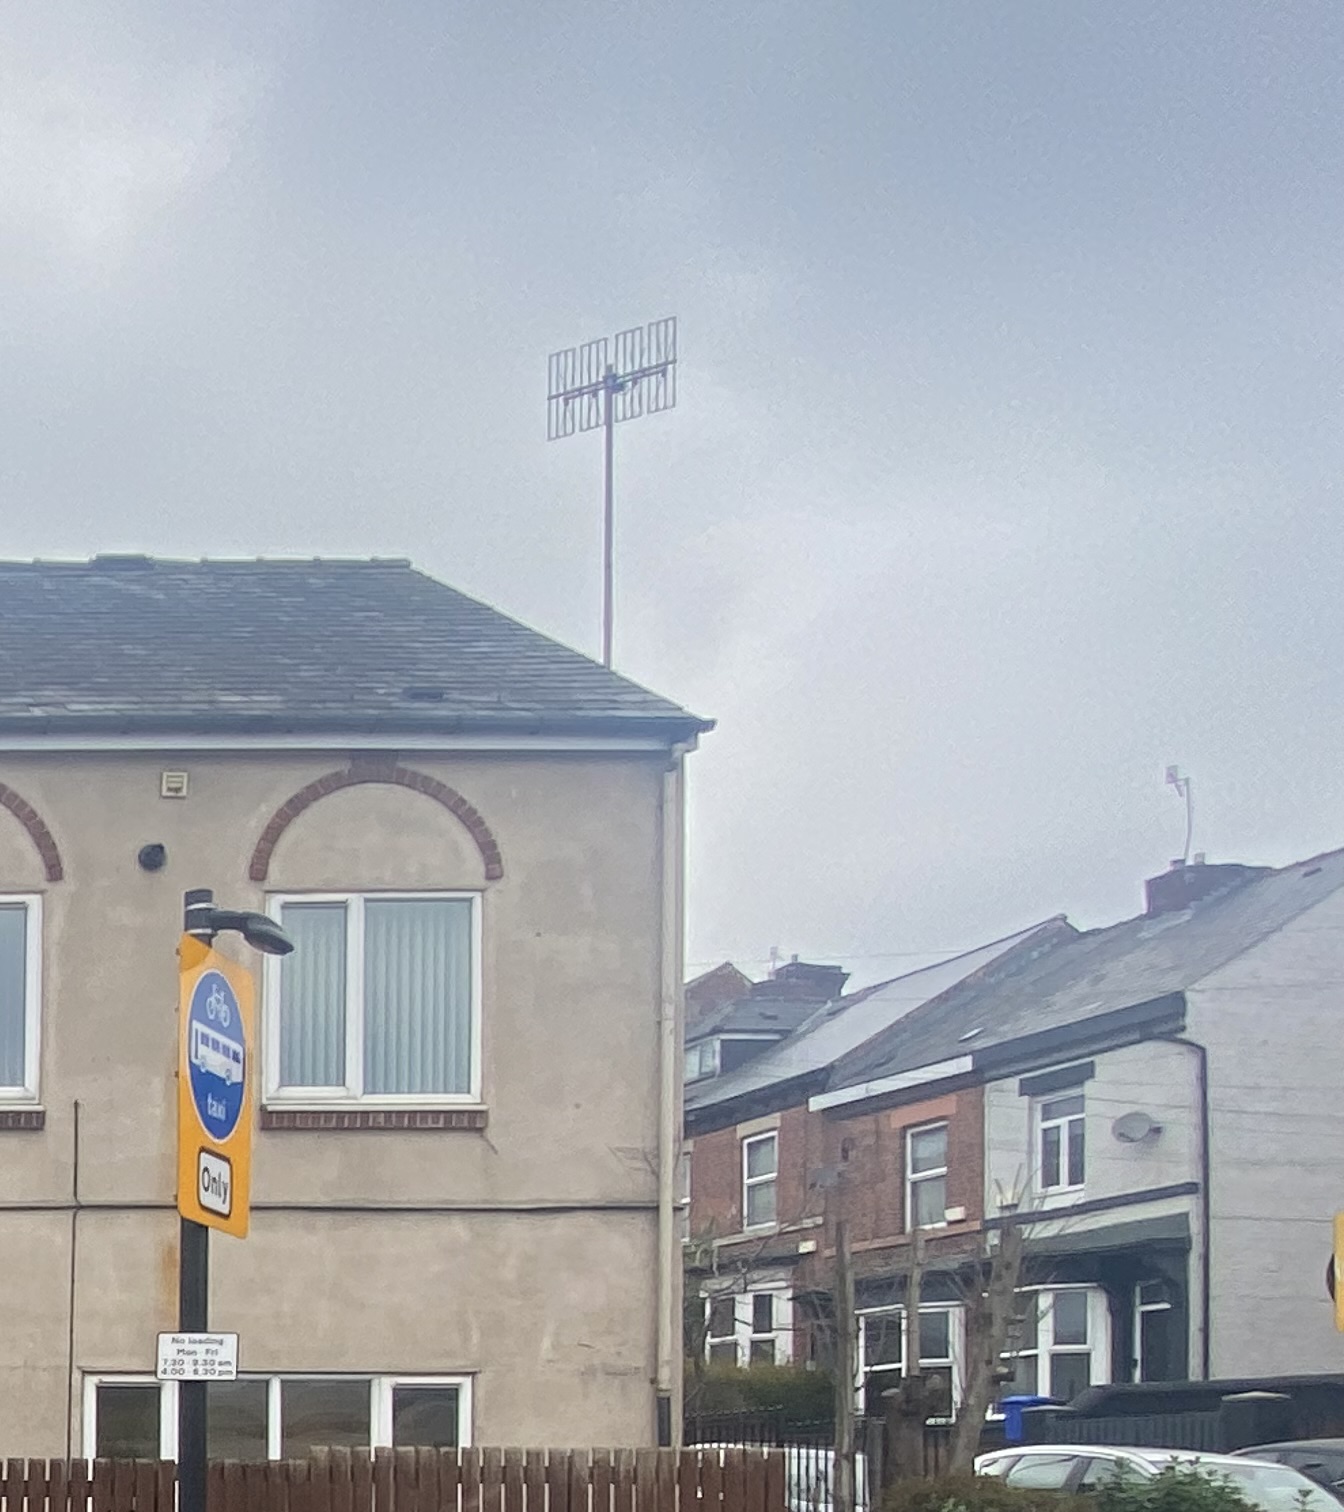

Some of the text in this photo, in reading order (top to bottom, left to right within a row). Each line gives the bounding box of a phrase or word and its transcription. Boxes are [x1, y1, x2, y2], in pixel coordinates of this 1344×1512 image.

[207, 1092, 226, 1122] taxi
[201, 1165, 229, 1206] Only
[171, 1337, 186, 1345] No
[176, 1348, 219, 1357] Mon Fri
